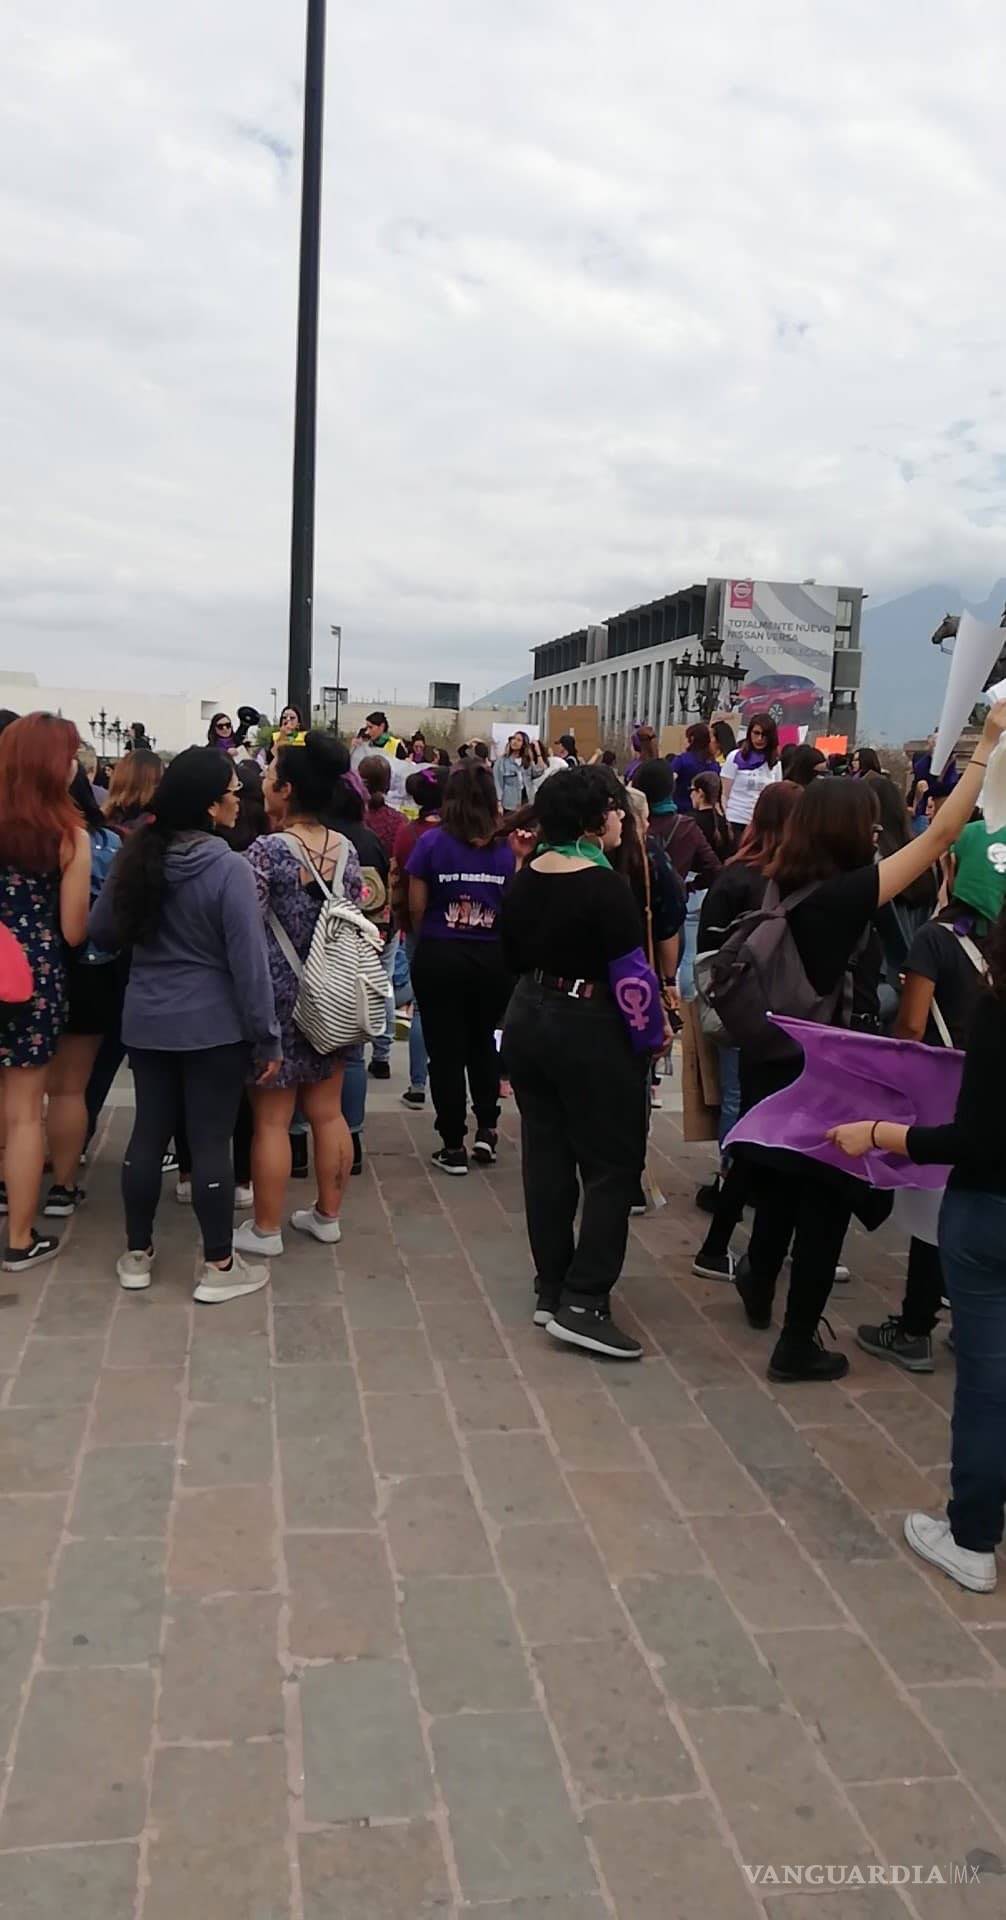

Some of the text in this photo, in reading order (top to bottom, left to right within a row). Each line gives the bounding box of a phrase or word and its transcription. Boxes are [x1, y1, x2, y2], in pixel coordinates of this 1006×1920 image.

[728, 619, 831, 633] TOTALMENTE NUEVO
[727, 630, 798, 641] NISSAN VERSA
